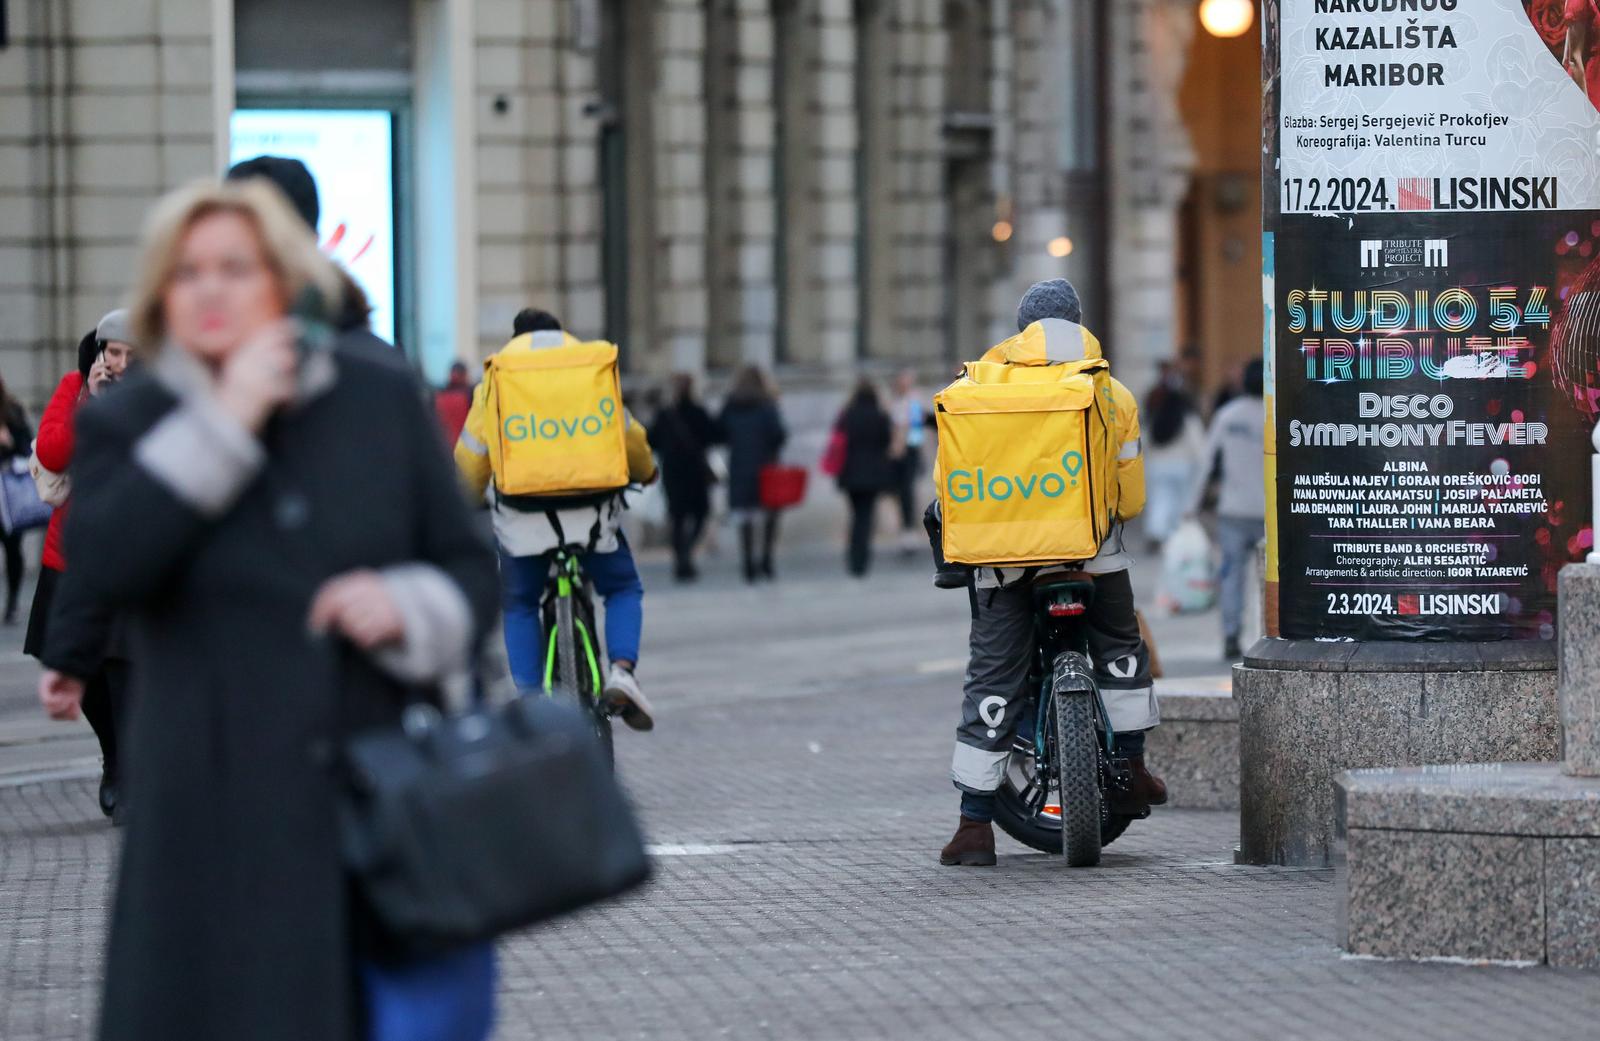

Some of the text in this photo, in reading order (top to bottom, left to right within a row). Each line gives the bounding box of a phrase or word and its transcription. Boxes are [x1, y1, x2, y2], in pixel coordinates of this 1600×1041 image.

[1315, 18, 1458, 50] KAZALIŠTA
[1324, 63, 1445, 87] MARIBOR
[1284, 112, 1509, 130] Glazba: Sergej Sergejevič Prokofjev
[1296, 133, 1487, 150] Koreografija: Valentina Turcu
[1284, 176, 1558, 211] 17.2.2024. LISINSKI
[1384, 240, 1423, 248] TRIBUTE
[1384, 253, 1422, 263] PROJECT
[1287, 287, 1551, 334] STUDIO 54
[1302, 336, 1529, 380] TRIBUTE
[504, 413, 602, 441] Glovo
[1383, 461, 1428, 472] ALBINA
[947, 468, 1065, 503] Glovo
[1294, 471, 1541, 486] ANA URŠULA NAJEV GORAN OREŠKOVIĆ GOGI
[1293, 488, 1543, 501] IVANA DUVNJAK AKAMATSU JOSIP PALAMETA
[1290, 499, 1548, 514] LARA DEMARIN LAURA JOHN MARIJA TATAREVIĆ
[1328, 518, 1496, 528] TARA THALLER VANA BEARA
[1333, 543, 1489, 553] ITTRIBUTE BAND & ORCHESTRA
[1336, 552, 1487, 567] Choreography: ALEN SESARTIĆ
[1305, 563, 1529, 578] Arrangements & artistic direction: IGOR TATAREVIĆ
[1327, 593, 1500, 615] 2.3.2024. LISINSKI
